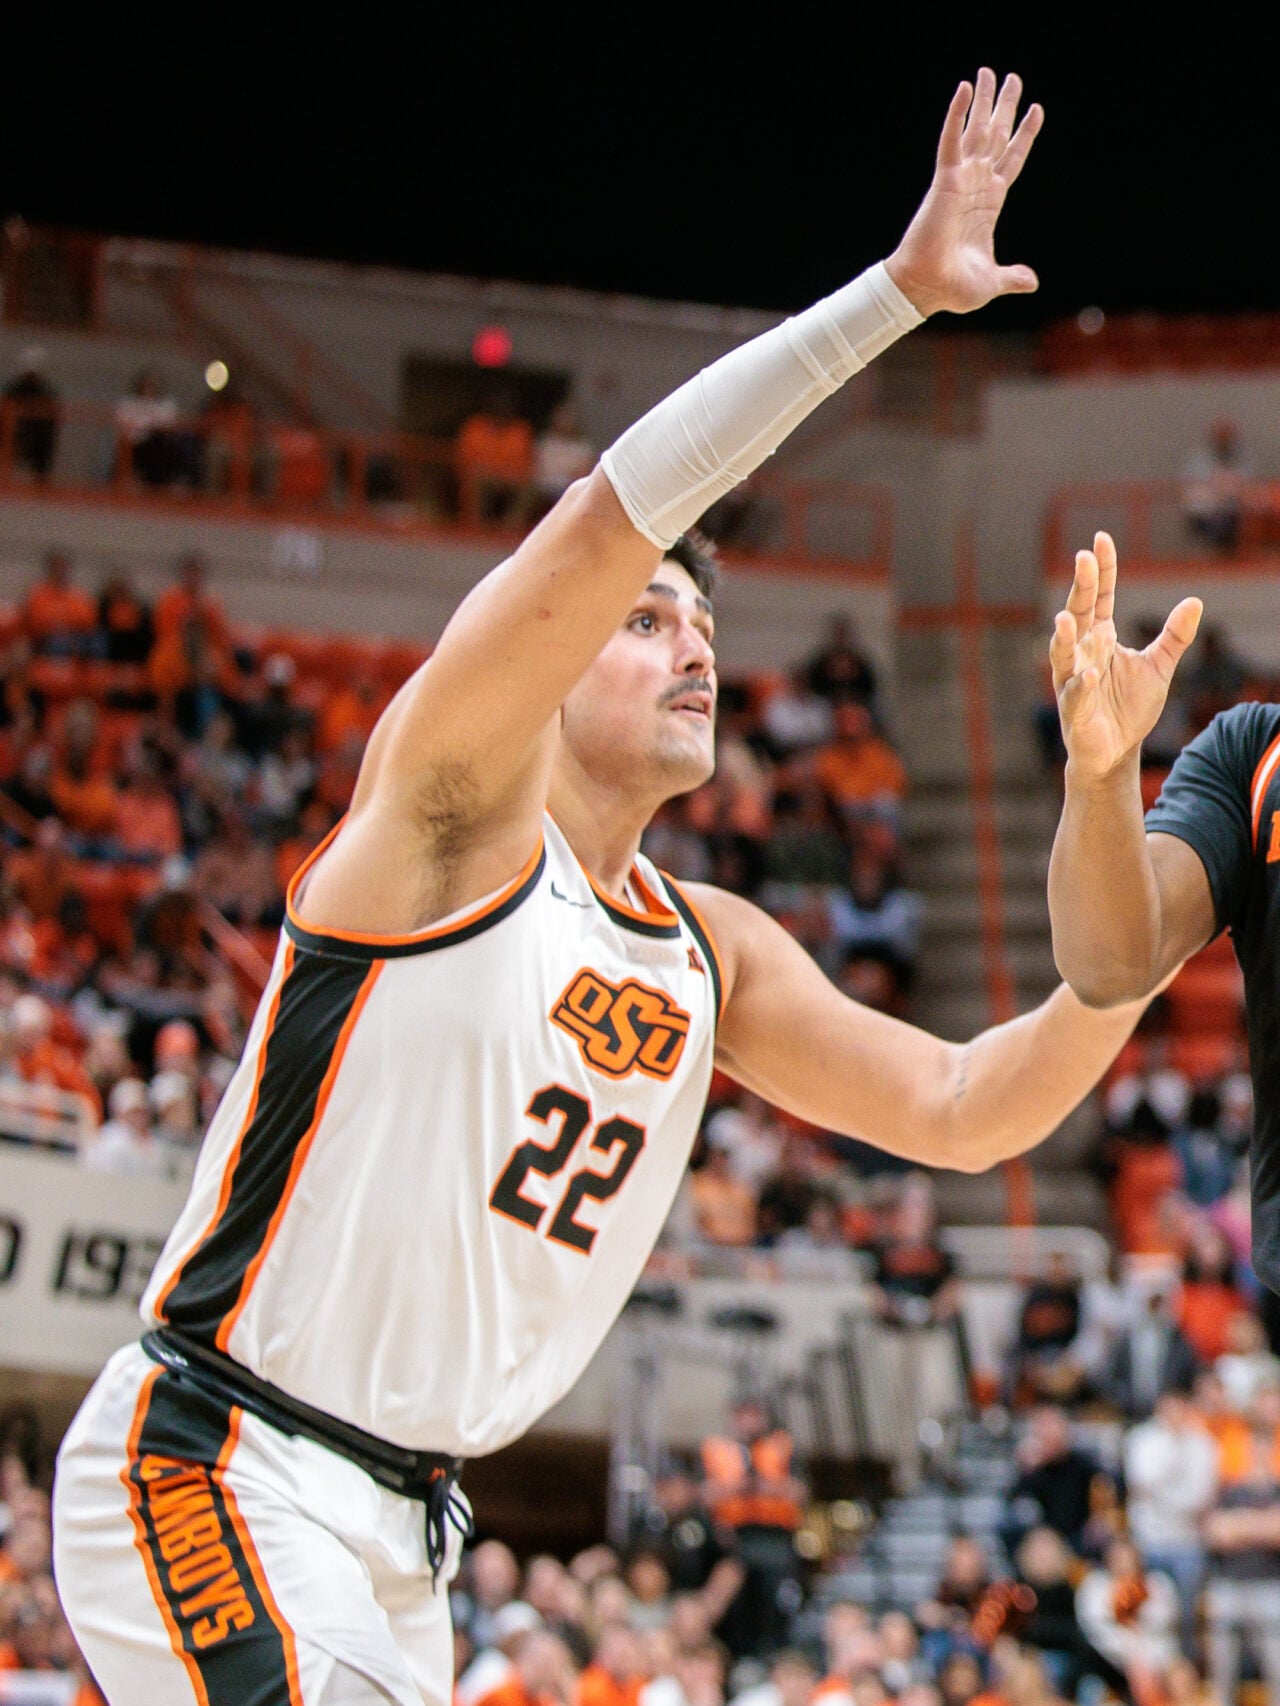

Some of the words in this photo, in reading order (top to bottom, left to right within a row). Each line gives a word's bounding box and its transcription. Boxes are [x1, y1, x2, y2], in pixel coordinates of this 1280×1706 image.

[548, 966, 692, 1082] OSU
[488, 1082, 648, 1257] 22
[139, 1454, 256, 1650] COWBOYS
